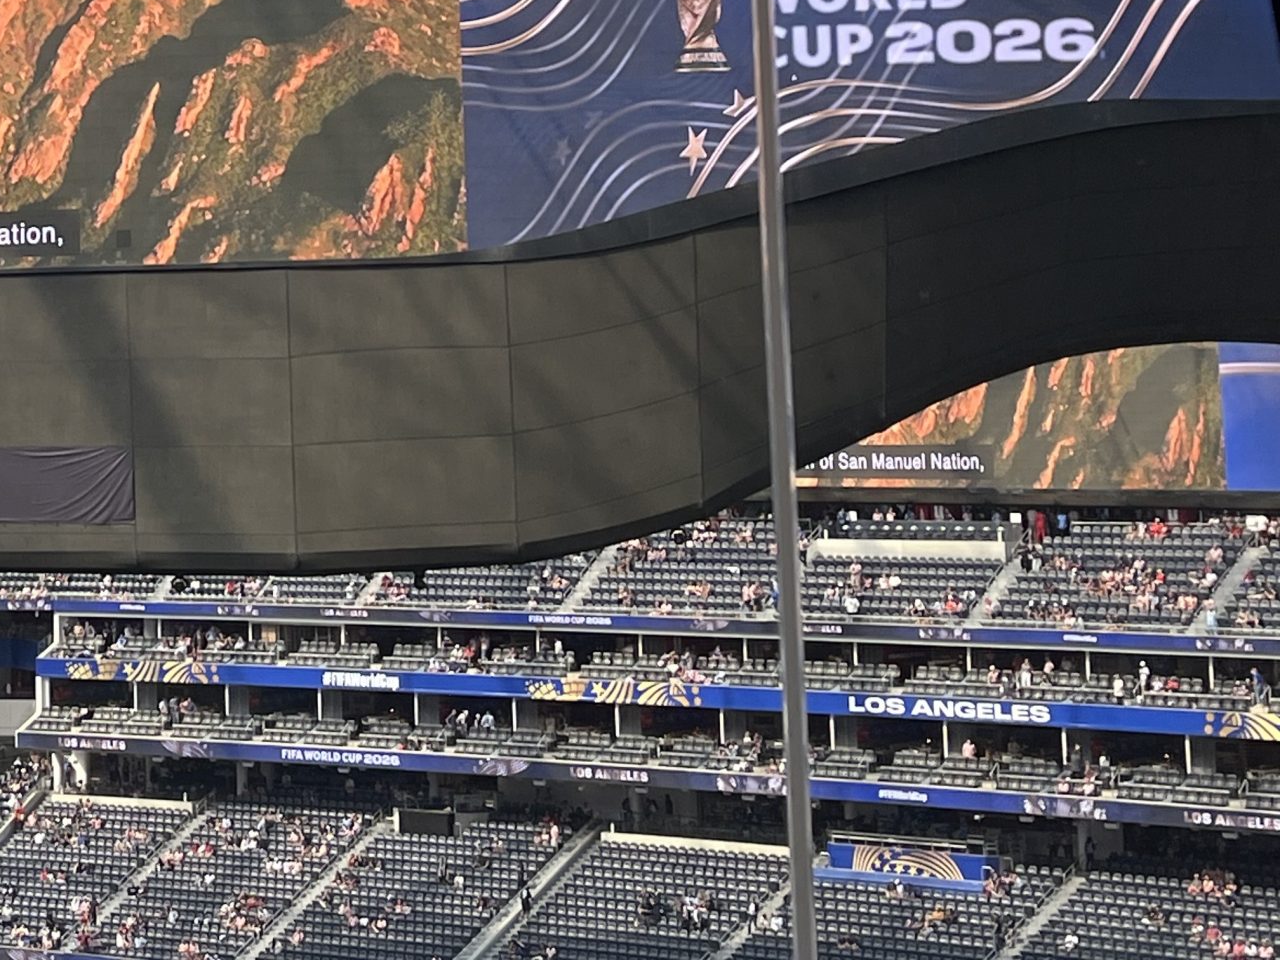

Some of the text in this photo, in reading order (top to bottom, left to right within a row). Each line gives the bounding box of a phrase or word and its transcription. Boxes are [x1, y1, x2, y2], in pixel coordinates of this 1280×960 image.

[885, 17, 1097, 65] 2026
[819, 453, 834, 470] of
[838, 452, 867, 470] San
[871, 452, 926, 470] Manuel
[931, 452, 985, 473] Nation,
[528, 615, 544, 623] FIFA
[544, 615, 570, 624] WORLD
[570, 616, 585, 624] CUP
[848, 696, 1051, 723] LOS ANGELES
[281, 749, 400, 766] FIFA WORLD CUP 2026
[570, 766, 592, 779] LOS
[1183, 811, 1212, 825] LOS
